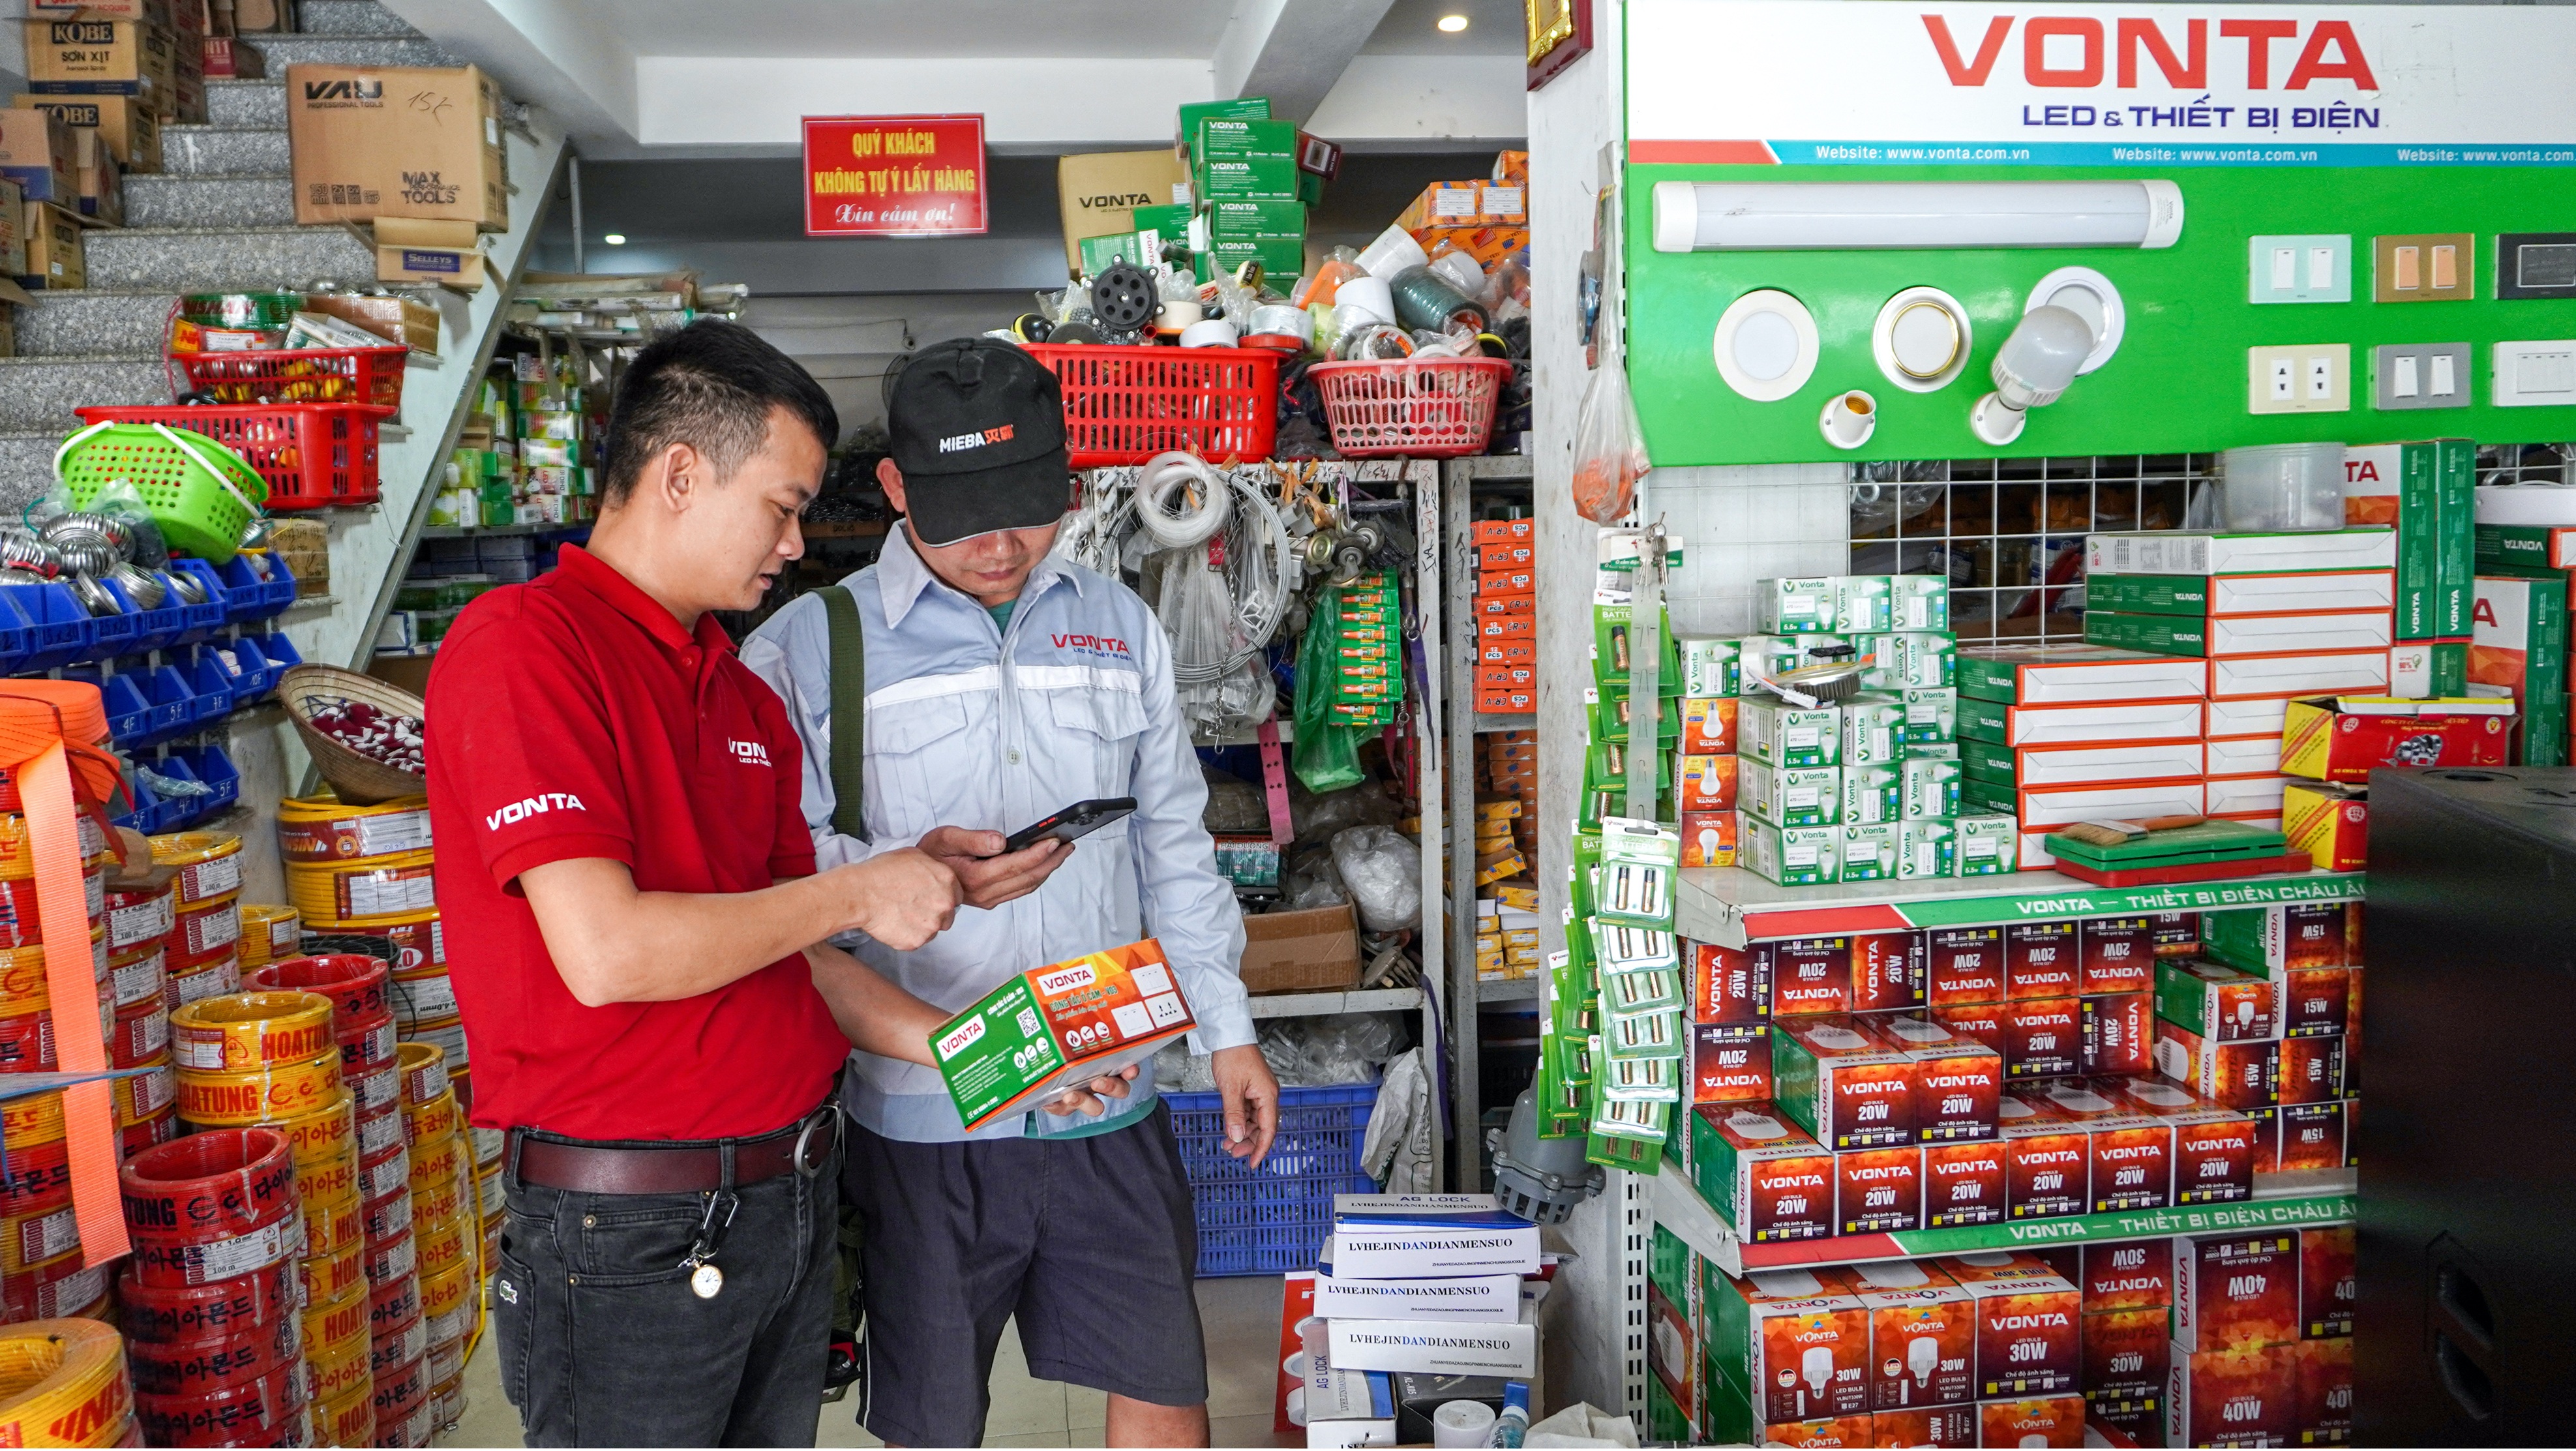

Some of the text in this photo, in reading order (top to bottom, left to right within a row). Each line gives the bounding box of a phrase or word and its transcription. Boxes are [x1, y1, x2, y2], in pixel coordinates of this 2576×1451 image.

[54, 22, 112, 44] KOBE
[1921, 14, 2379, 91] VONTA
[2024, 104, 2097, 127] LED
[2129, 94, 2235, 128] THIẾT
[2247, 107, 2280, 134] BỊ
[2291, 99, 2380, 135] ĐIỆN
[853, 128, 935, 157] QUÝ KHÁCH
[1816, 144, 2030, 160] Website: www.vonta.com.vn
[2112, 146, 2318, 162] Website: www.vonta.com.vn
[2397, 147, 2459, 163] Website:
[402, 171, 440, 184] MAX
[815, 162, 975, 197] KHÔNG TỰ Ý LẤY HÀNG
[401, 190, 456, 204] TOOLS
[1079, 193, 1152, 208] VONTA
[835, 202, 955, 223] Xin cảm ơn!
[1146, 234, 1155, 265] VONTA
[408, 254, 452, 263] SELLEYS
[939, 431, 985, 453] MIEBA
[2504, 539, 2543, 551] VONTA
[1509, 599, 1531, 609] CR-V
[1507, 621, 1529, 631] CR-V
[1051, 634, 1130, 654] VONTA
[1507, 647, 1529, 657] CR-V
[486, 792, 586, 831] VONTA
[1862, 826, 1888, 835] Vonta
[1981, 821, 2007, 831] Vonta
[1800, 831, 1827, 841] Vonta
[2016, 898, 2094, 914] VONTA
[2126, 888, 2196, 908] THIẾT
[2197, 891, 2217, 905] BỊ
[2221, 888, 2273, 903] ĐIỆN
[2278, 882, 2340, 899] CHÂU
[1868, 940, 1878, 1000] VONTA
[1043, 970, 1092, 989] VONTA
[1711, 955, 1722, 1015] VONTA
[2014, 1014, 2071, 1027] VONTA
[942, 1023, 981, 1053] VONTA
[1842, 1081, 1906, 1094] VONTA
[1926, 1075, 1990, 1088] VONTA
[1858, 1105, 1889, 1120] 20W
[1942, 1098, 1973, 1114] 20W
[2185, 1137, 2246, 1152] VONTA
[2018, 1150, 2079, 1165] VONTA
[2100, 1146, 2161, 1161] VONTA
[1849, 1166, 1912, 1180] VONTA
[1936, 1161, 1998, 1174] VONTA
[1760, 1175, 1824, 1189] VONTA
[1865, 1190, 1896, 1206] 20W
[1952, 1184, 1981, 1200] 20W
[1776, 1199, 1806, 1215] 20W
[2009, 1203, 2333, 1239] VONTA THIẾT BỊ ĐIỆN CHÂU
[1349, 1238, 1512, 1251] LVHEJINDANDIANMENSUO
[1328, 1285, 1490, 1296] LVHEJINDANDIANMENSUO
[1990, 1312, 2069, 1331] VONTA
[1349, 1334, 1510, 1351] LVHEJINDANDIANMENSUO
[1795, 1331, 1839, 1343] VONTA
[2009, 1341, 2047, 1362] 30W
[1315, 1354, 1328, 1389] AG LOCK
[1941, 1358, 1965, 1371] 30W
[1836, 1368, 1861, 1381] 30W
